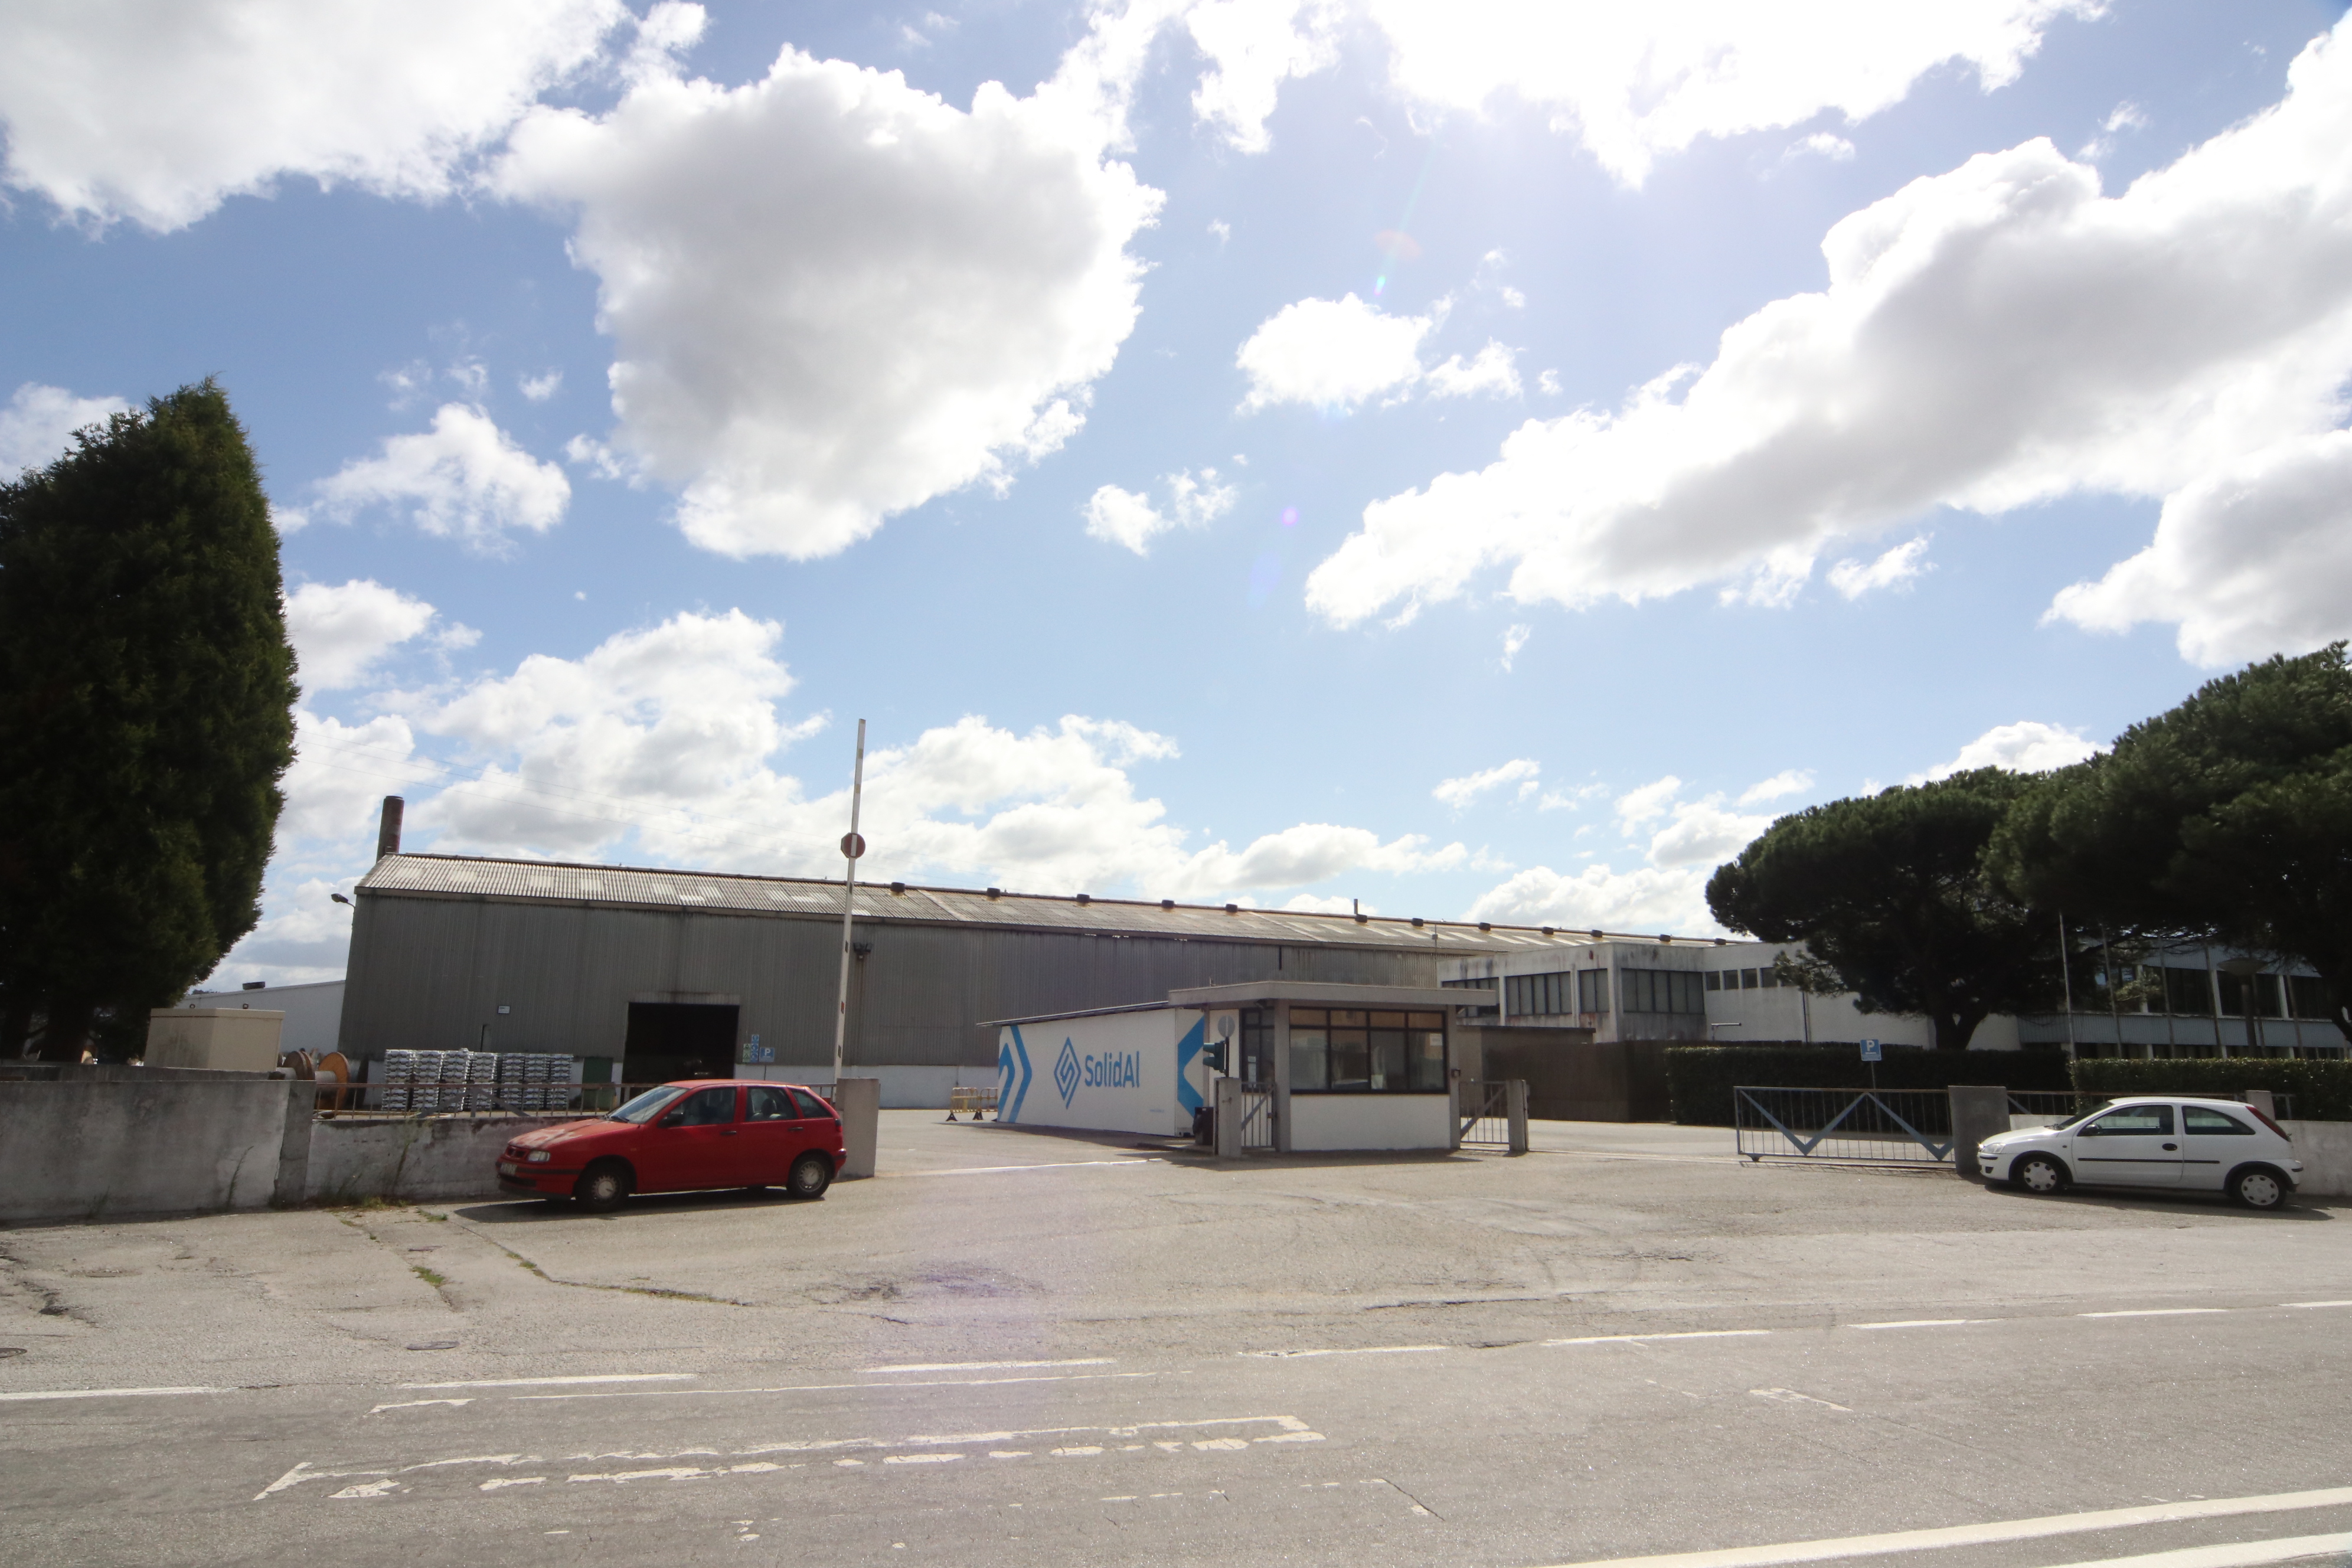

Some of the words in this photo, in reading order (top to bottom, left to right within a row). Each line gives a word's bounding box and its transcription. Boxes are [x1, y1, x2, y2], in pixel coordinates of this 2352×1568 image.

[1867, 1040, 1875, 1051] P
[765, 1048, 771, 1056] P
[1084, 1051, 1140, 1088] SolidAl
